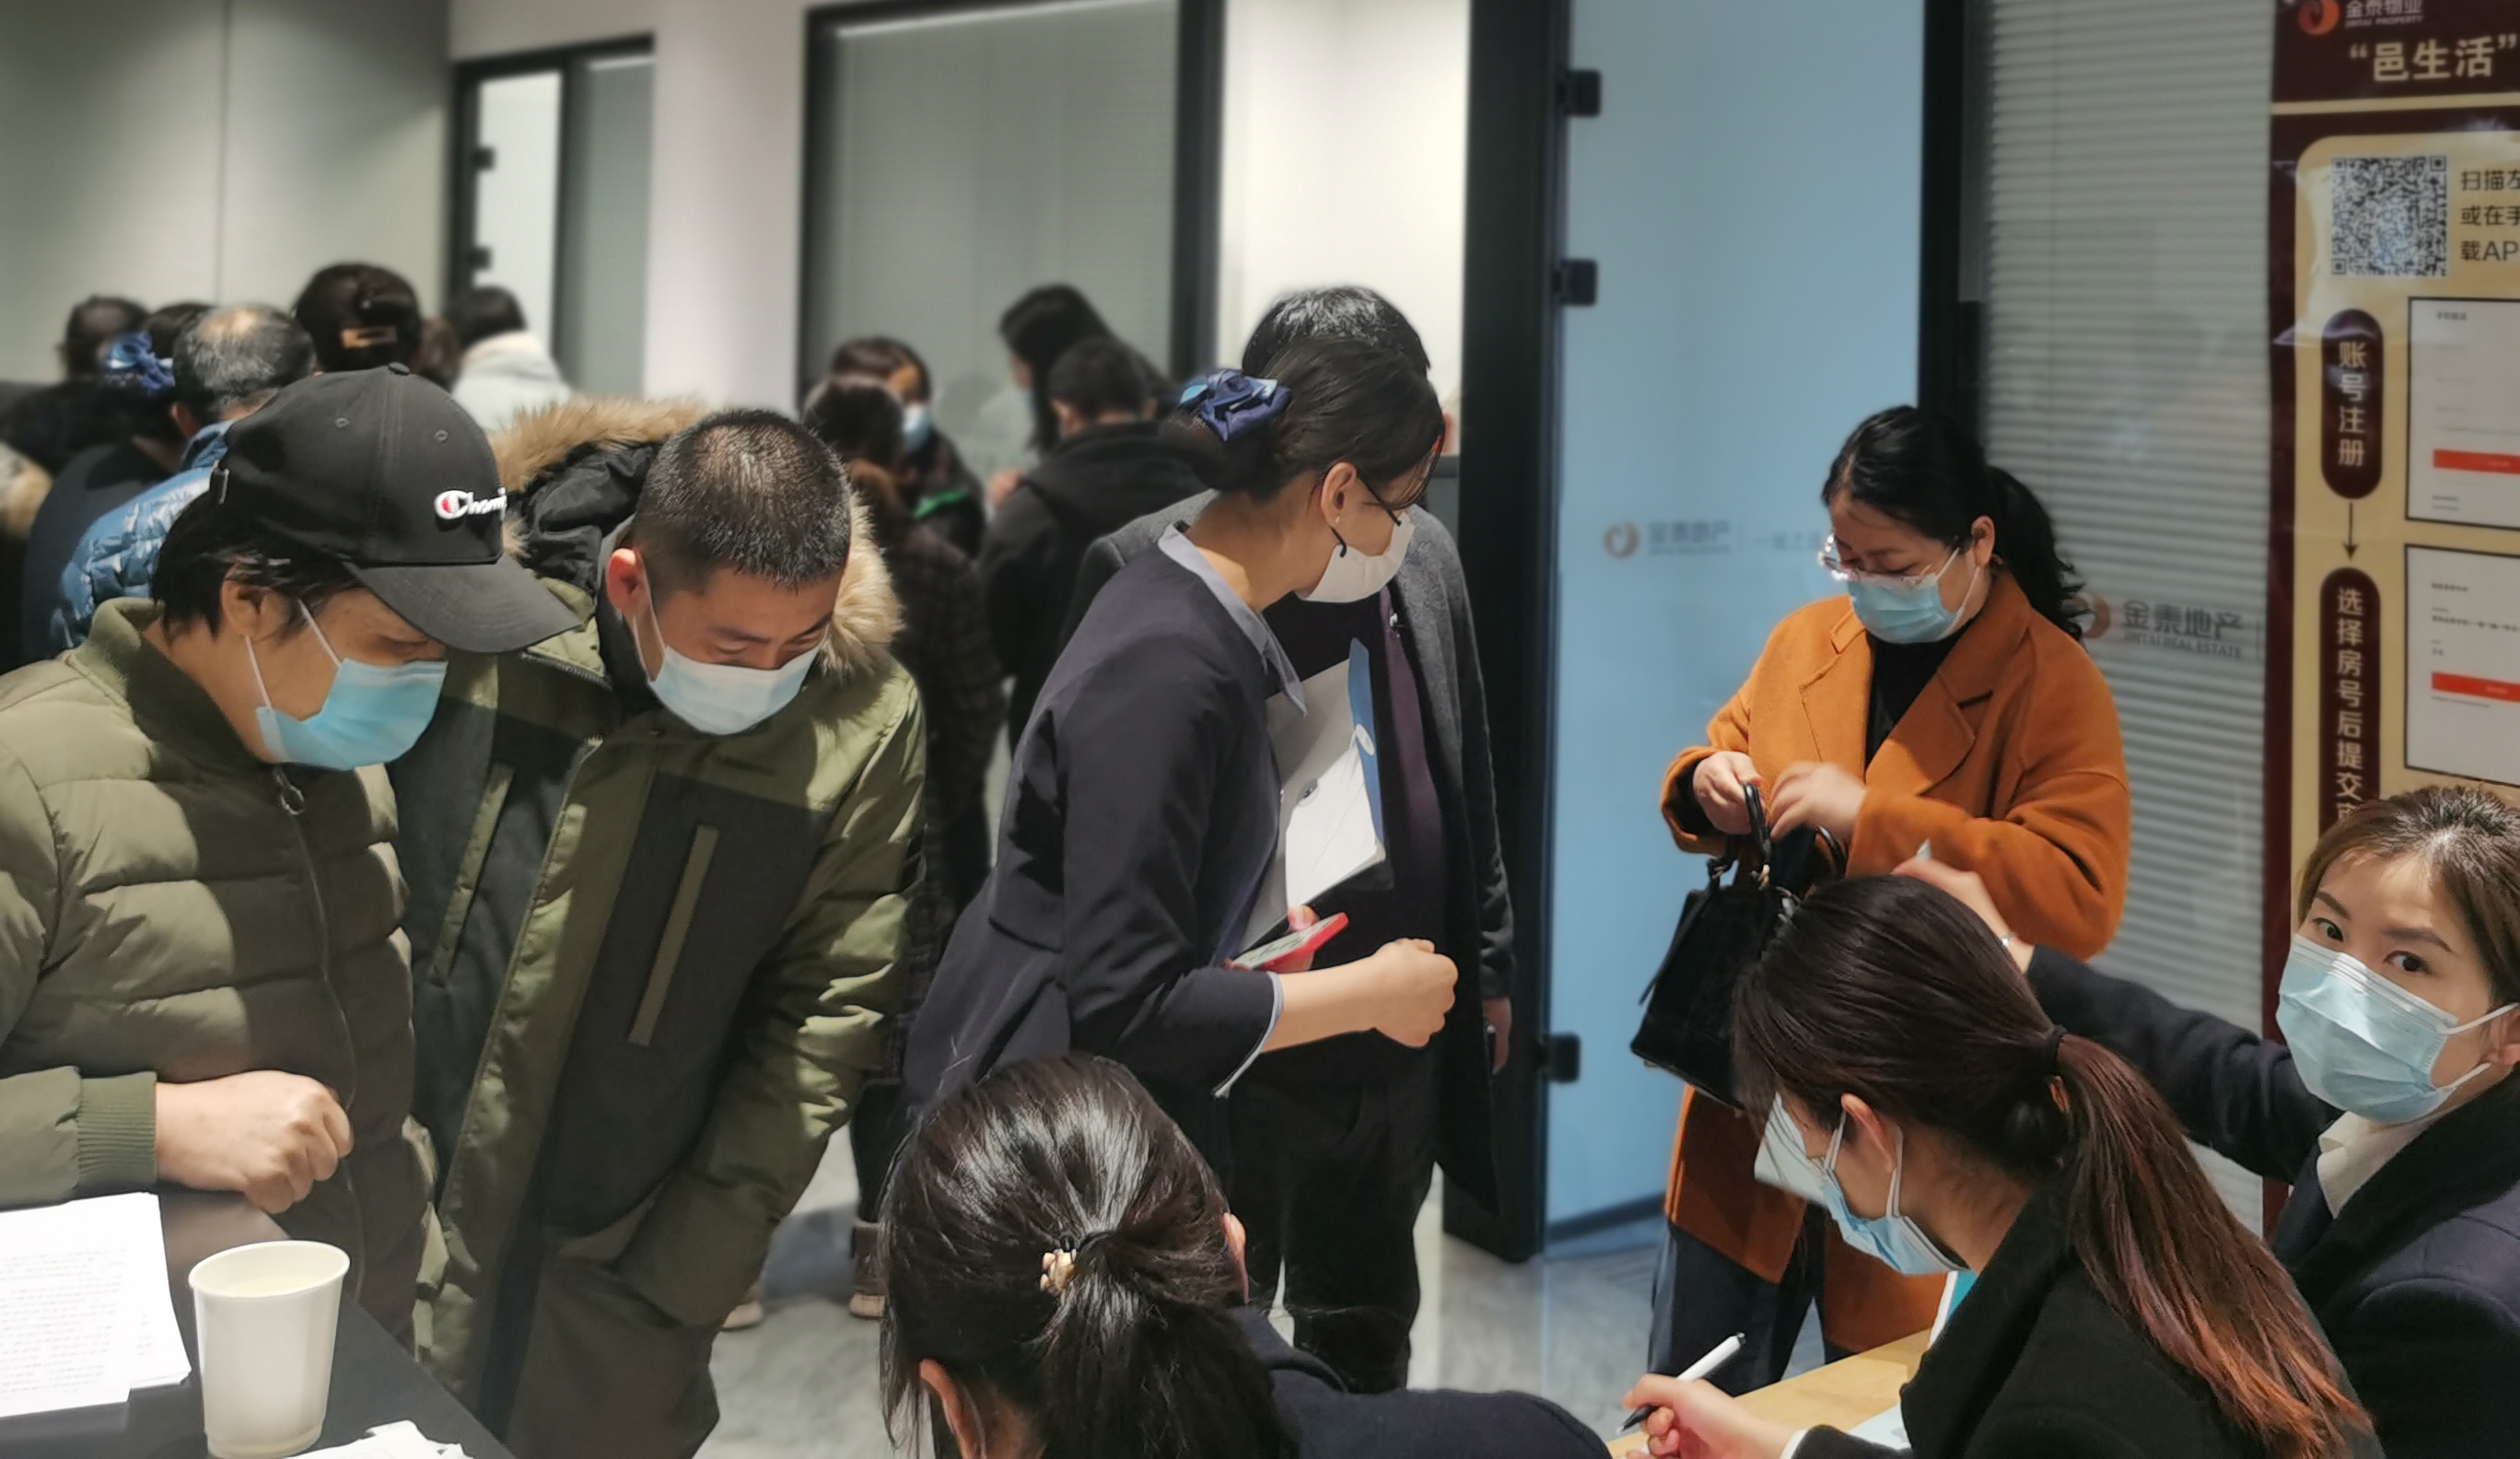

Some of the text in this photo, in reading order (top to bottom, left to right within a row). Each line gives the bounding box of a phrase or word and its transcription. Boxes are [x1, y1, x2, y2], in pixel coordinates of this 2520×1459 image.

[2338, 341, 2367, 467] 账号注册
[2122, 601, 2243, 640] 金泰地产
[2197, 640, 2241, 659] ESTATE
